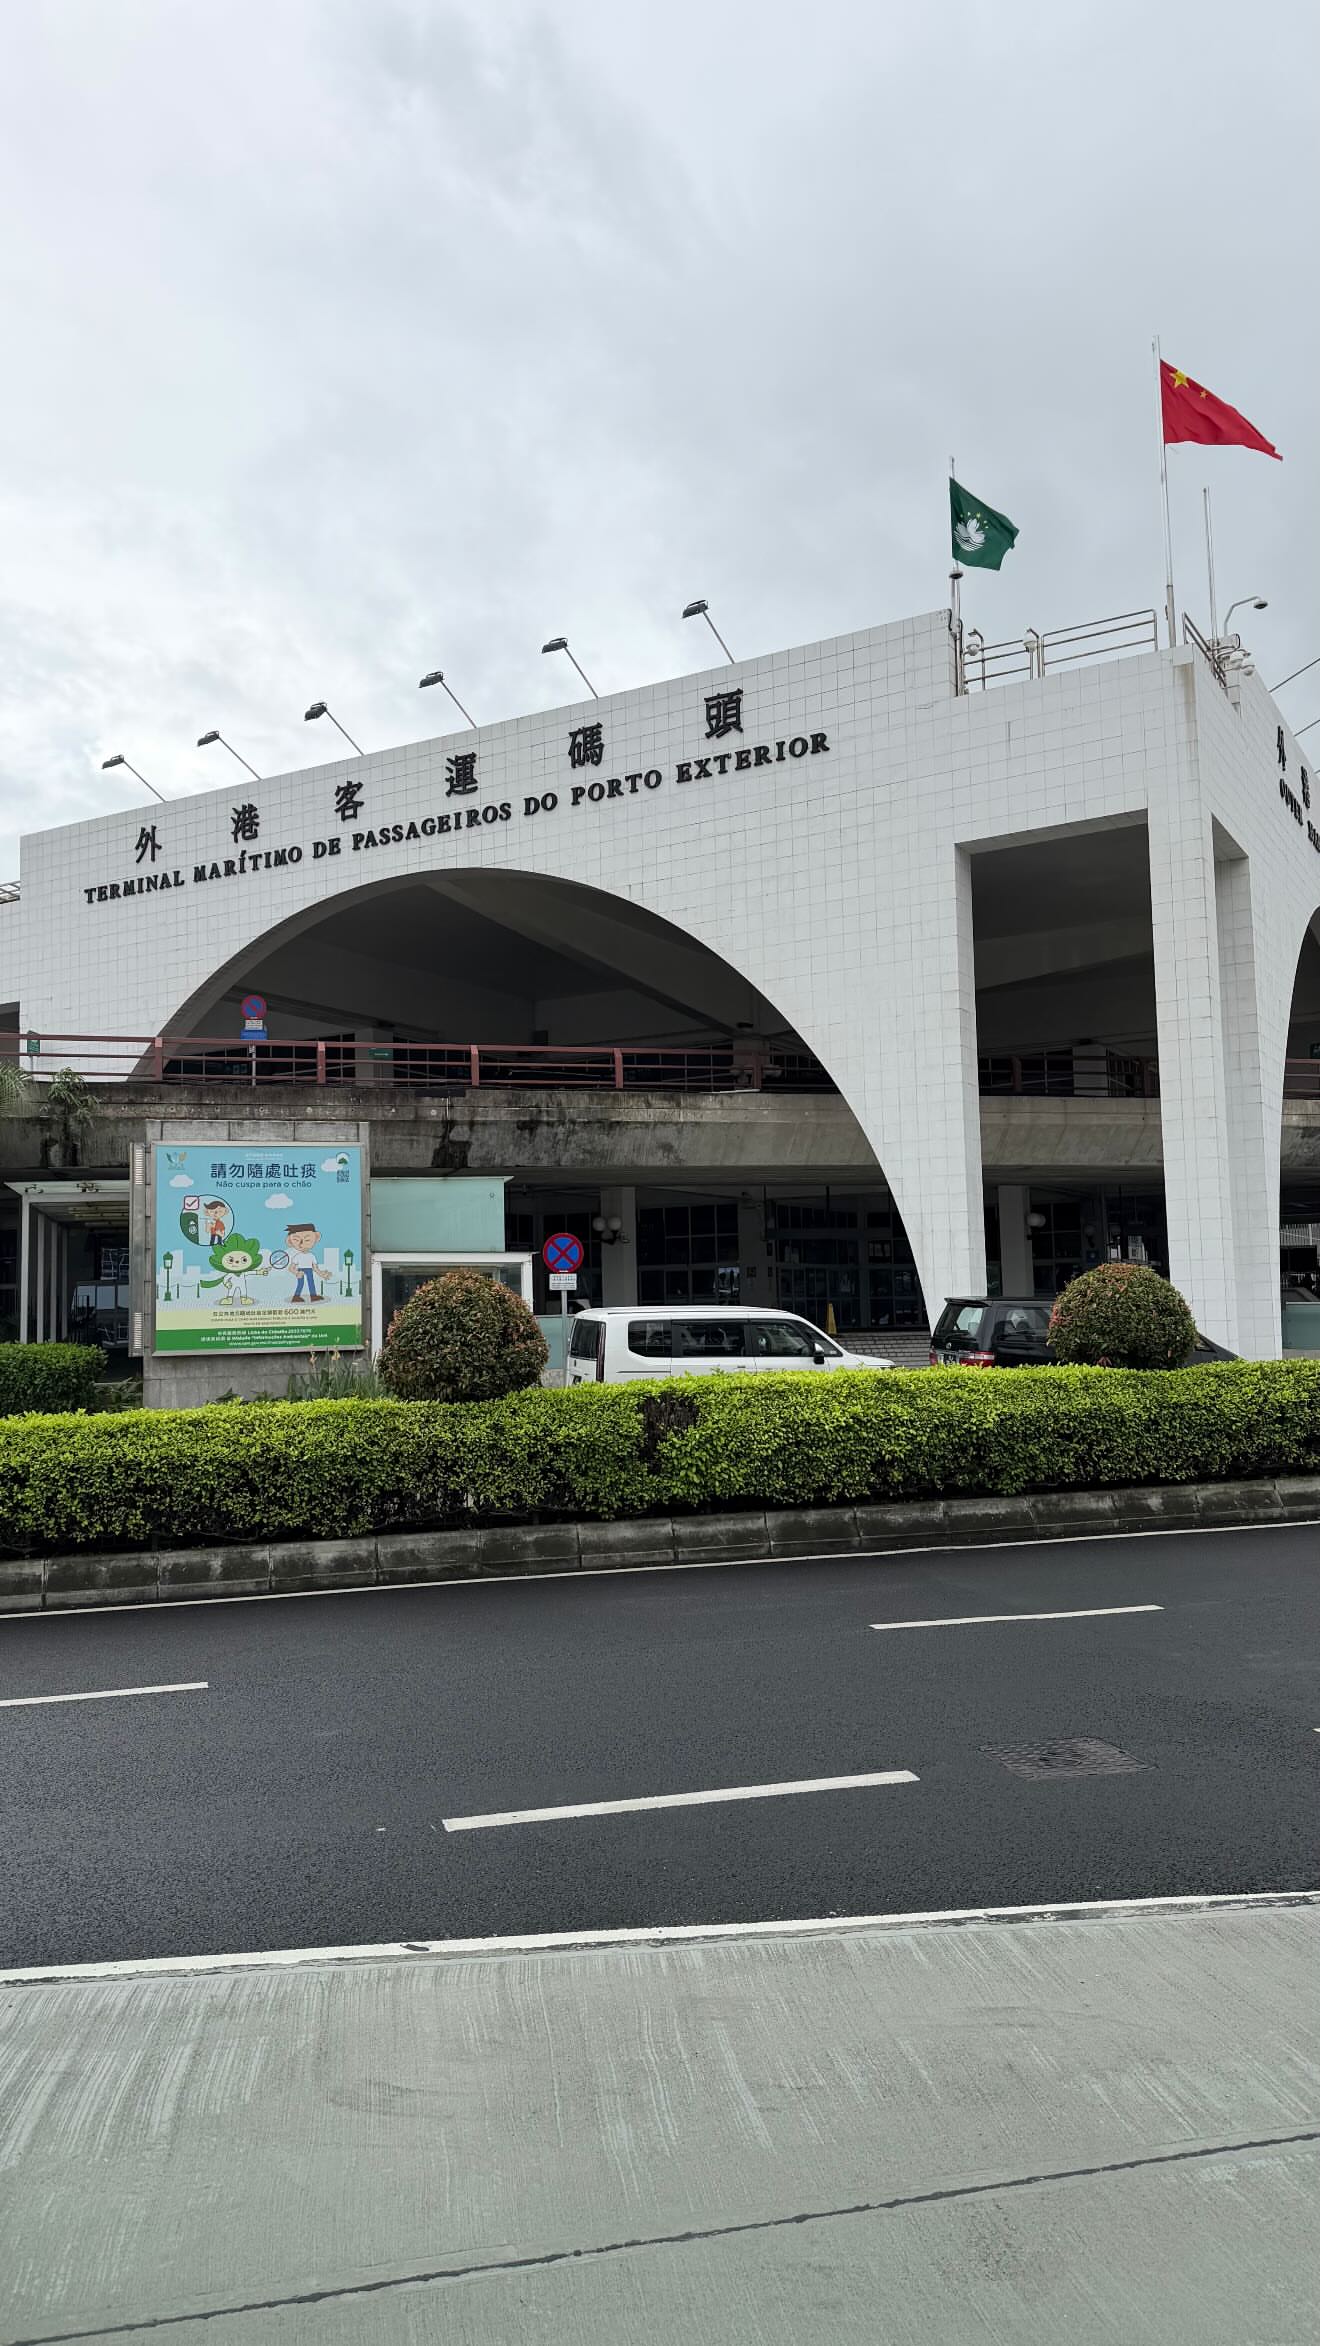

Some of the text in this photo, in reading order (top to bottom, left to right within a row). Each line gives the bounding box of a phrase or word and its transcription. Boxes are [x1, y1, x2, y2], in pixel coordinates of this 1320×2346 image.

[84, 731, 831, 905] TERMINAL MARÍTIMO DE PASSAGEIROS DO PORTO EXTERIOR
[135, 688, 744, 864] 外港客運碼頭
[210, 1163, 317, 1179] 請勿隨處吐痰
[216, 1180, 234, 1188] Não
[235, 1182, 260, 1190] cuspa
[262, 1182, 282, 1190] para
